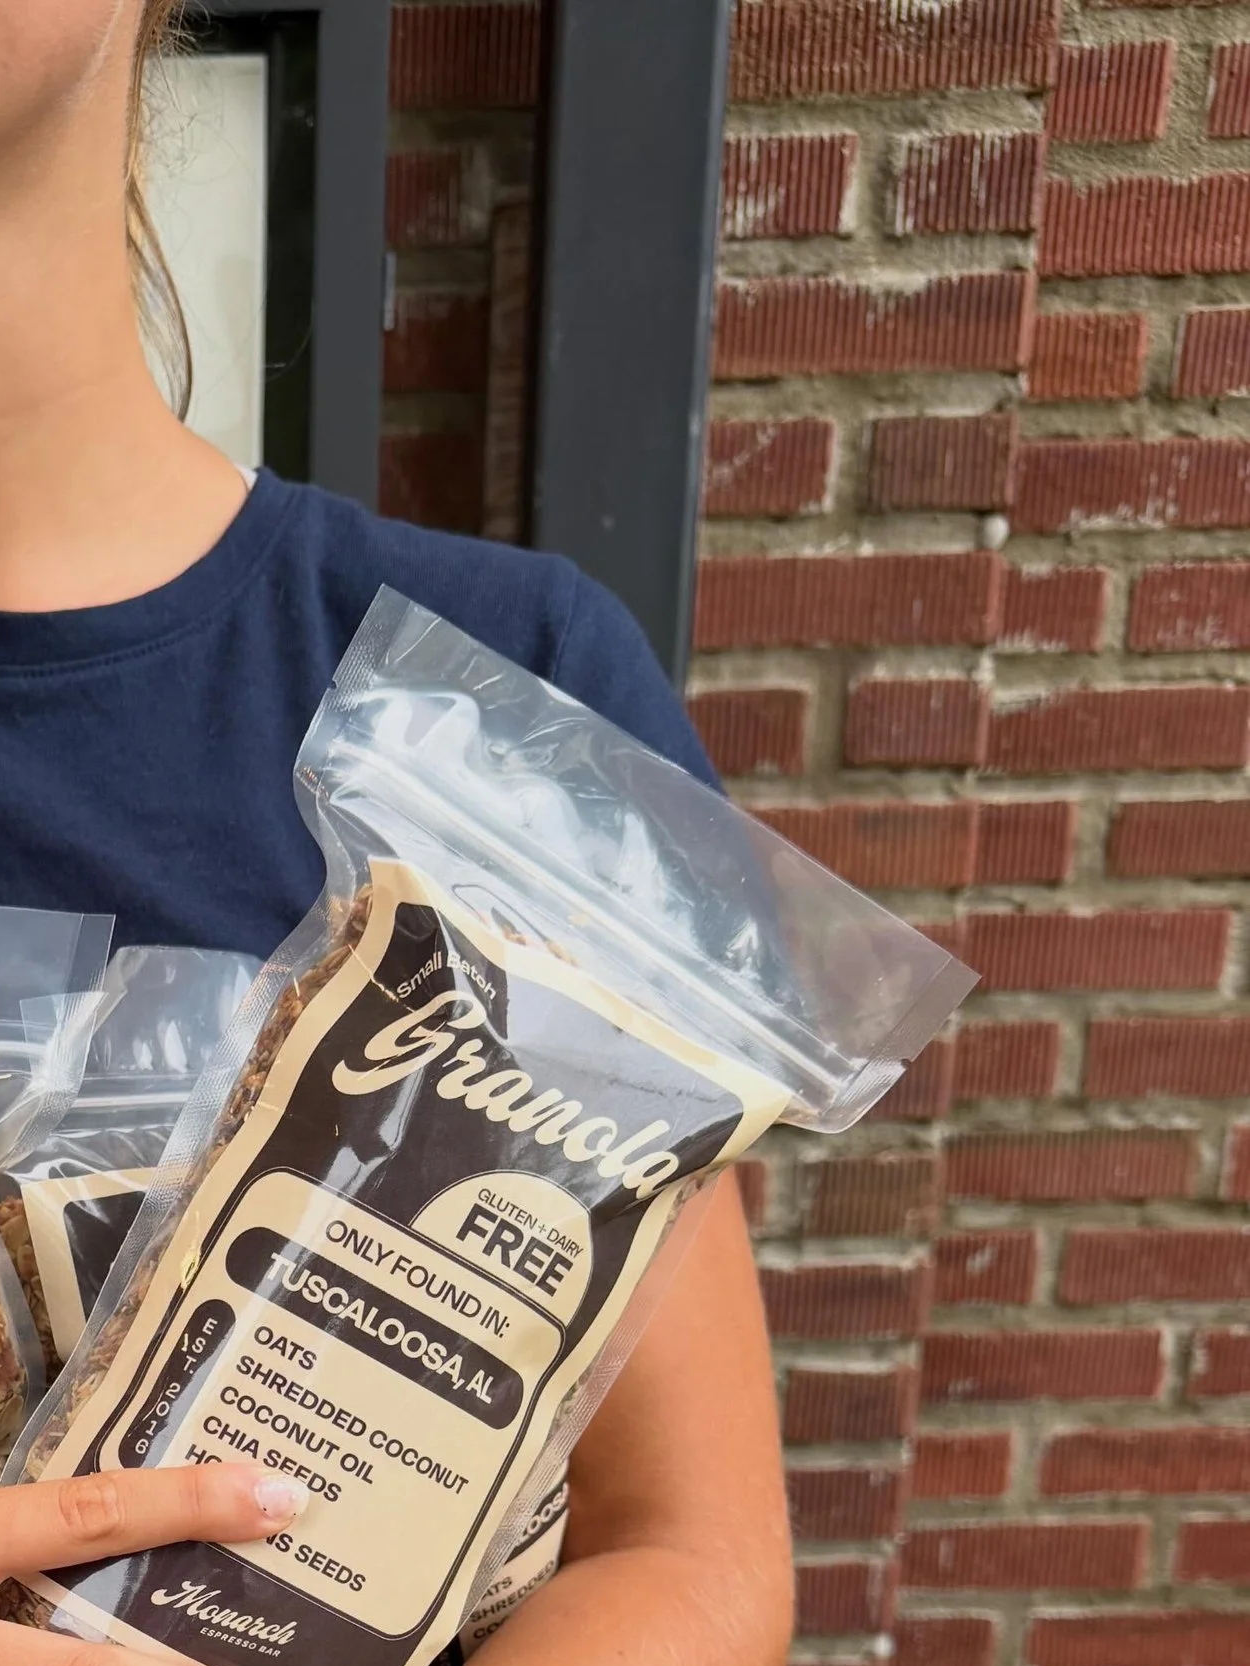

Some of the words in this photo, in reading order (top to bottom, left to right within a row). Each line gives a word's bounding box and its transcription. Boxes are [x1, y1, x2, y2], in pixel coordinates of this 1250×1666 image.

[396, 951, 442, 999] Small
[331, 989, 680, 1200] Granola
[455, 1203, 575, 1299] FREE
[477, 1187, 535, 1233] GLUTEN
[547, 1227, 585, 1259] DAIRY
[325, 1219, 395, 1270] ONLY
[391, 1258, 484, 1322] FOUND
[480, 1312, 513, 1340] IN:
[253, 1325, 319, 1371] OATS
[267, 1253, 467, 1387] TUSCALOOSA,
[464, 1375, 495, 1405] AL
[202, 1415, 260, 1460] CHIA
[262, 1448, 343, 1503] SEEDS
[218, 1385, 341, 1461] COCONUT
[339, 1452, 375, 1485] OIL
[235, 1354, 368, 1438] SHREDDED
[368, 1429, 470, 1496] COCONUT
[294, 1543, 366, 1593] SEEDS
[470, 1560, 555, 1622] SHREDDED
[481, 1576, 512, 1600] ATS
[150, 1580, 299, 1645] Monarch
[199, 1626, 257, 1651] ESPRESSO
[258, 1644, 282, 1658] BAR
